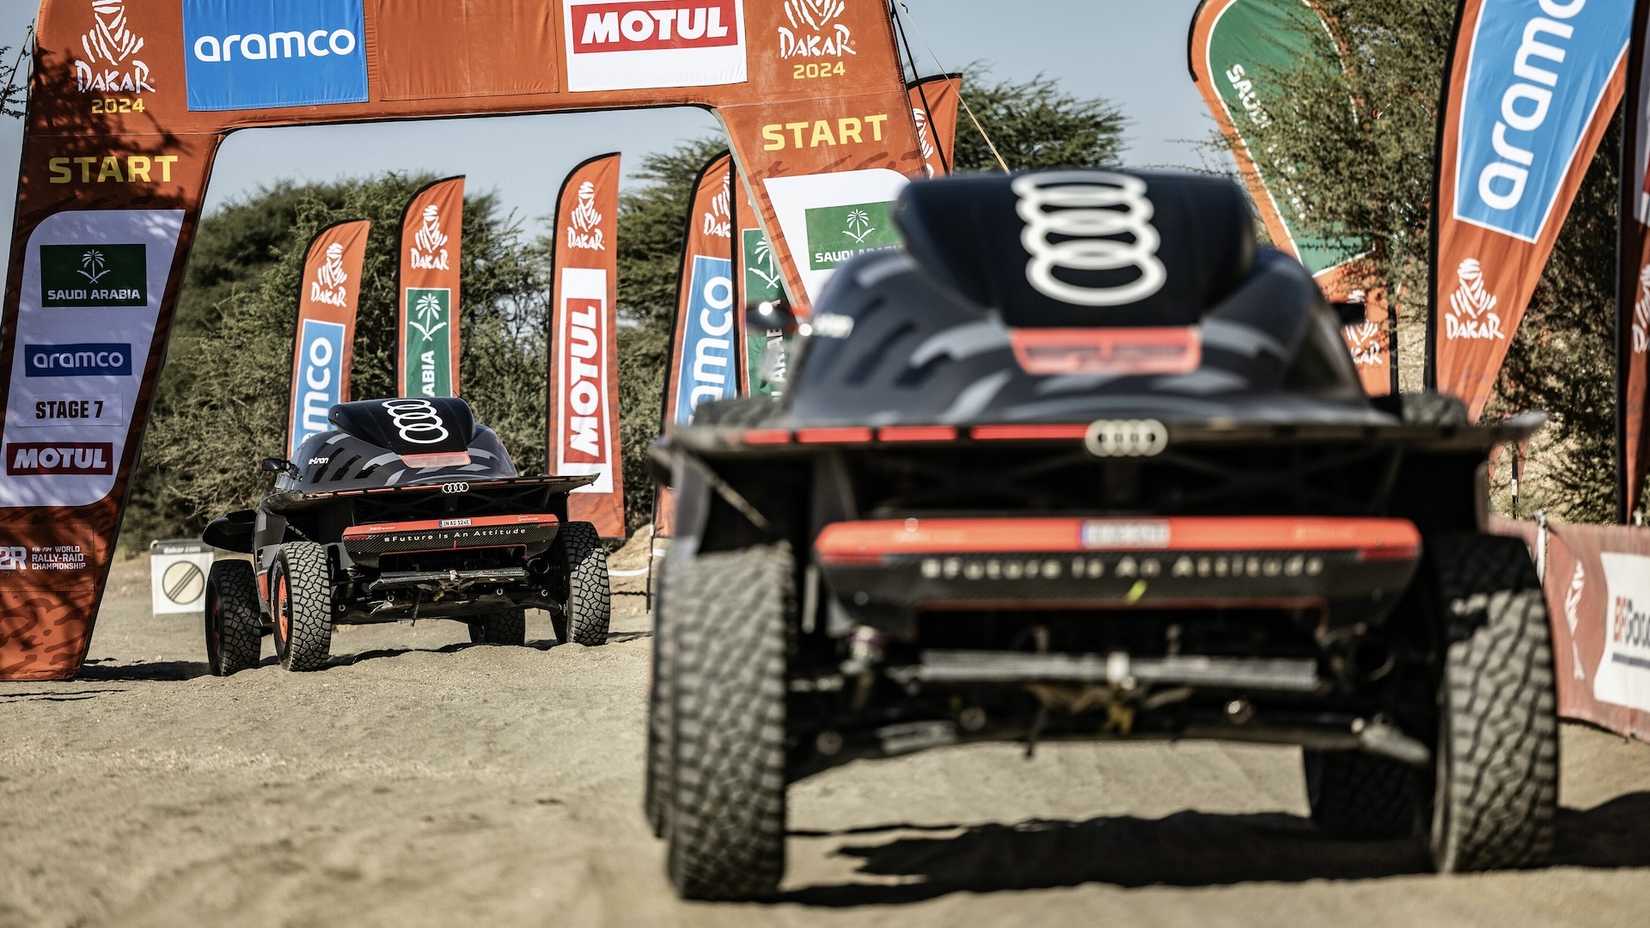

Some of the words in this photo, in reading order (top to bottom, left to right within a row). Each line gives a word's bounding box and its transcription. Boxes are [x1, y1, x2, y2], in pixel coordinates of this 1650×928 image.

[580, 7, 729, 45] MOTUL
[194, 29, 356, 62] aramco
[778, 24, 857, 59] DAKAR
[75, 60, 156, 94] DAKAR
[793, 61, 846, 79] 2024
[91, 98, 145, 114] 2024
[762, 114, 888, 151] START
[49, 155, 178, 184] START
[567, 226, 605, 251] DAKAR
[410, 248, 449, 271] DAKAR
[47, 289, 87, 300] SAUDI
[90, 288, 141, 300] ARABIA
[310, 282, 347, 308] DAKAR
[1445, 312, 1505, 341] DAKAR
[33, 351, 124, 368] aramco
[688, 276, 733, 423] amco
[300, 336, 333, 443] mco
[570, 305, 599, 458] MOTUL
[35, 400, 89, 419] STAGE
[94, 400, 104, 418] 7
[13, 448, 107, 469] MOTUL
[473, 527, 526, 536] Attitude
[32, 553, 84, 563] RALLY-RAID
[32, 562, 86, 570] CHAMPIONSHIP
